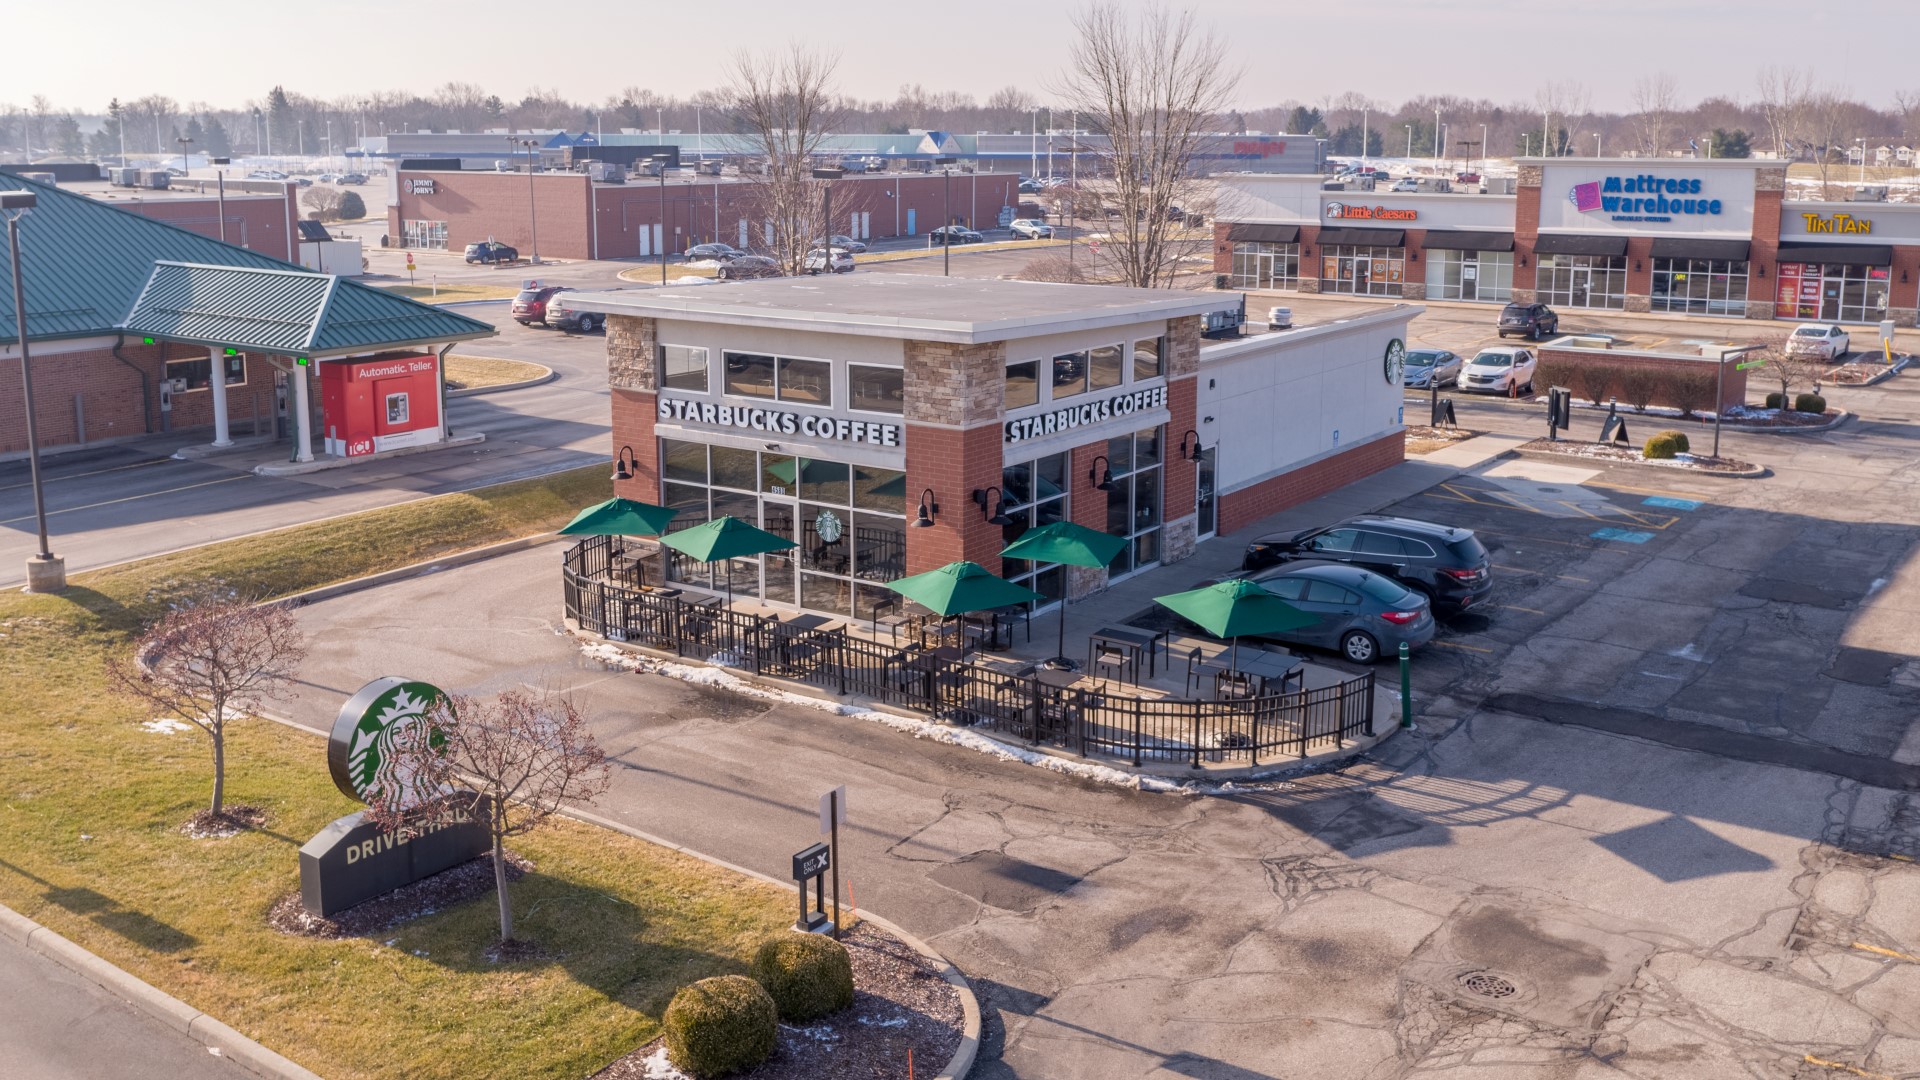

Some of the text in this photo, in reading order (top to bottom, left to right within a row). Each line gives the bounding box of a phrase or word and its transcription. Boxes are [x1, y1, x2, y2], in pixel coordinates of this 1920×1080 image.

[413, 179, 434, 187] JIMMY
[413, 187, 434, 196] JOHN'S
[1603, 175, 1701, 194] Mattress
[1343, 205, 1417, 220] Little Caesars
[1601, 194, 1722, 215] Warehouse
[359, 361, 433, 378] Automatic. Teller.
[659, 398, 900, 447] STARBUCKS COFFEE
[1005, 386, 1168, 443] STARBUCKS COFFEE
[346, 826, 410, 865] DRIVE
[803, 858, 815, 869] EXIT
[803, 863, 818, 875] ONLY
